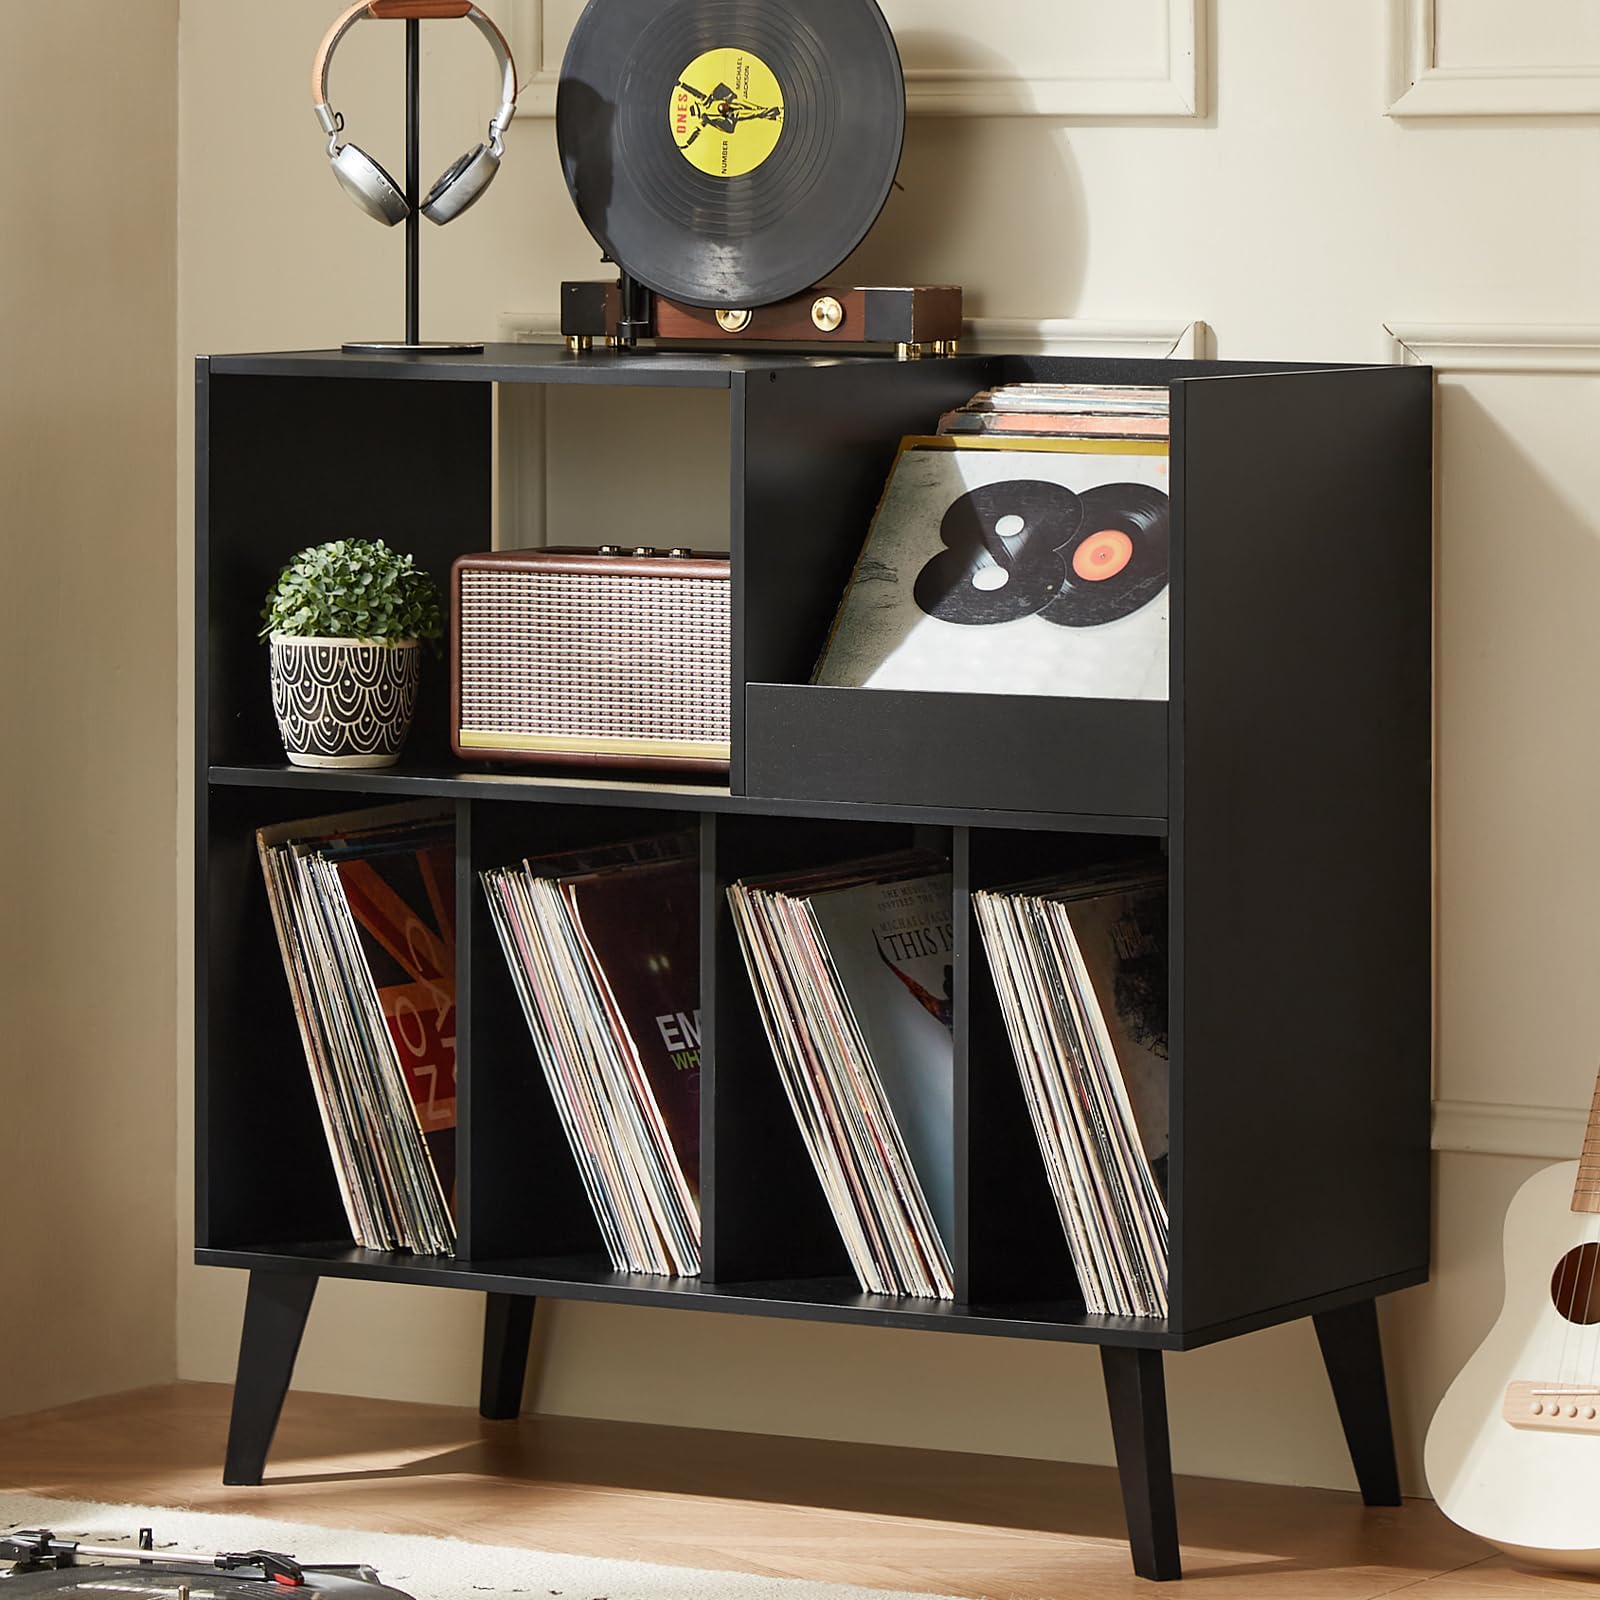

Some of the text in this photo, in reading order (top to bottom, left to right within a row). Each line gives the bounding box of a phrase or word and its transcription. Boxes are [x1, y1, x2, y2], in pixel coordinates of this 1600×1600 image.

[676, 93, 688, 134] ONES
[721, 140, 729, 174] NUMBER
[884, 927, 938, 961] THIS
[671, 1048, 702, 1070] WH
